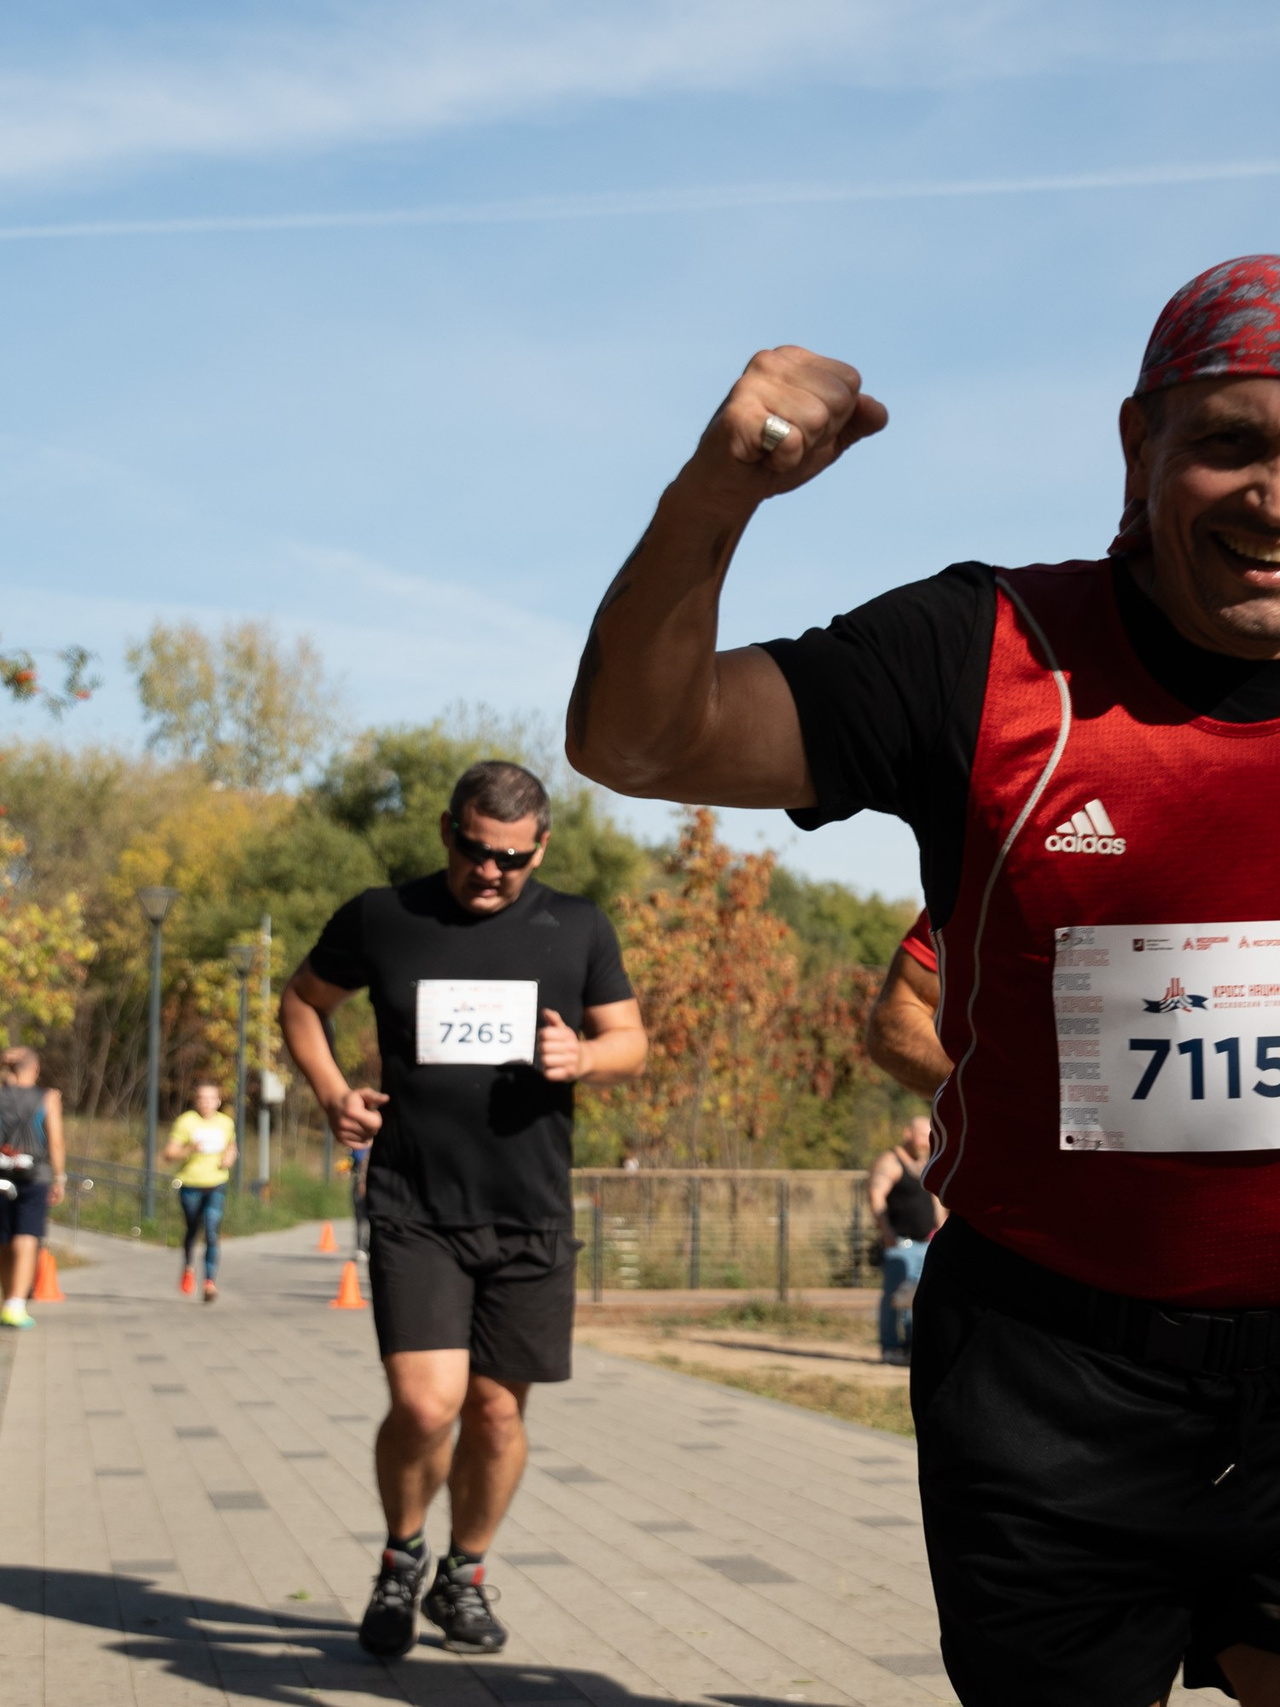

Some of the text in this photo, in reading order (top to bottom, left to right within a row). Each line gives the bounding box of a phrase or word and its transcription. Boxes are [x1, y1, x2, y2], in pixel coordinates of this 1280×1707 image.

[1045, 833, 1127, 855] adidas
[1212, 984, 1246, 998] КРОСС
[440, 1022, 513, 1044] 7265
